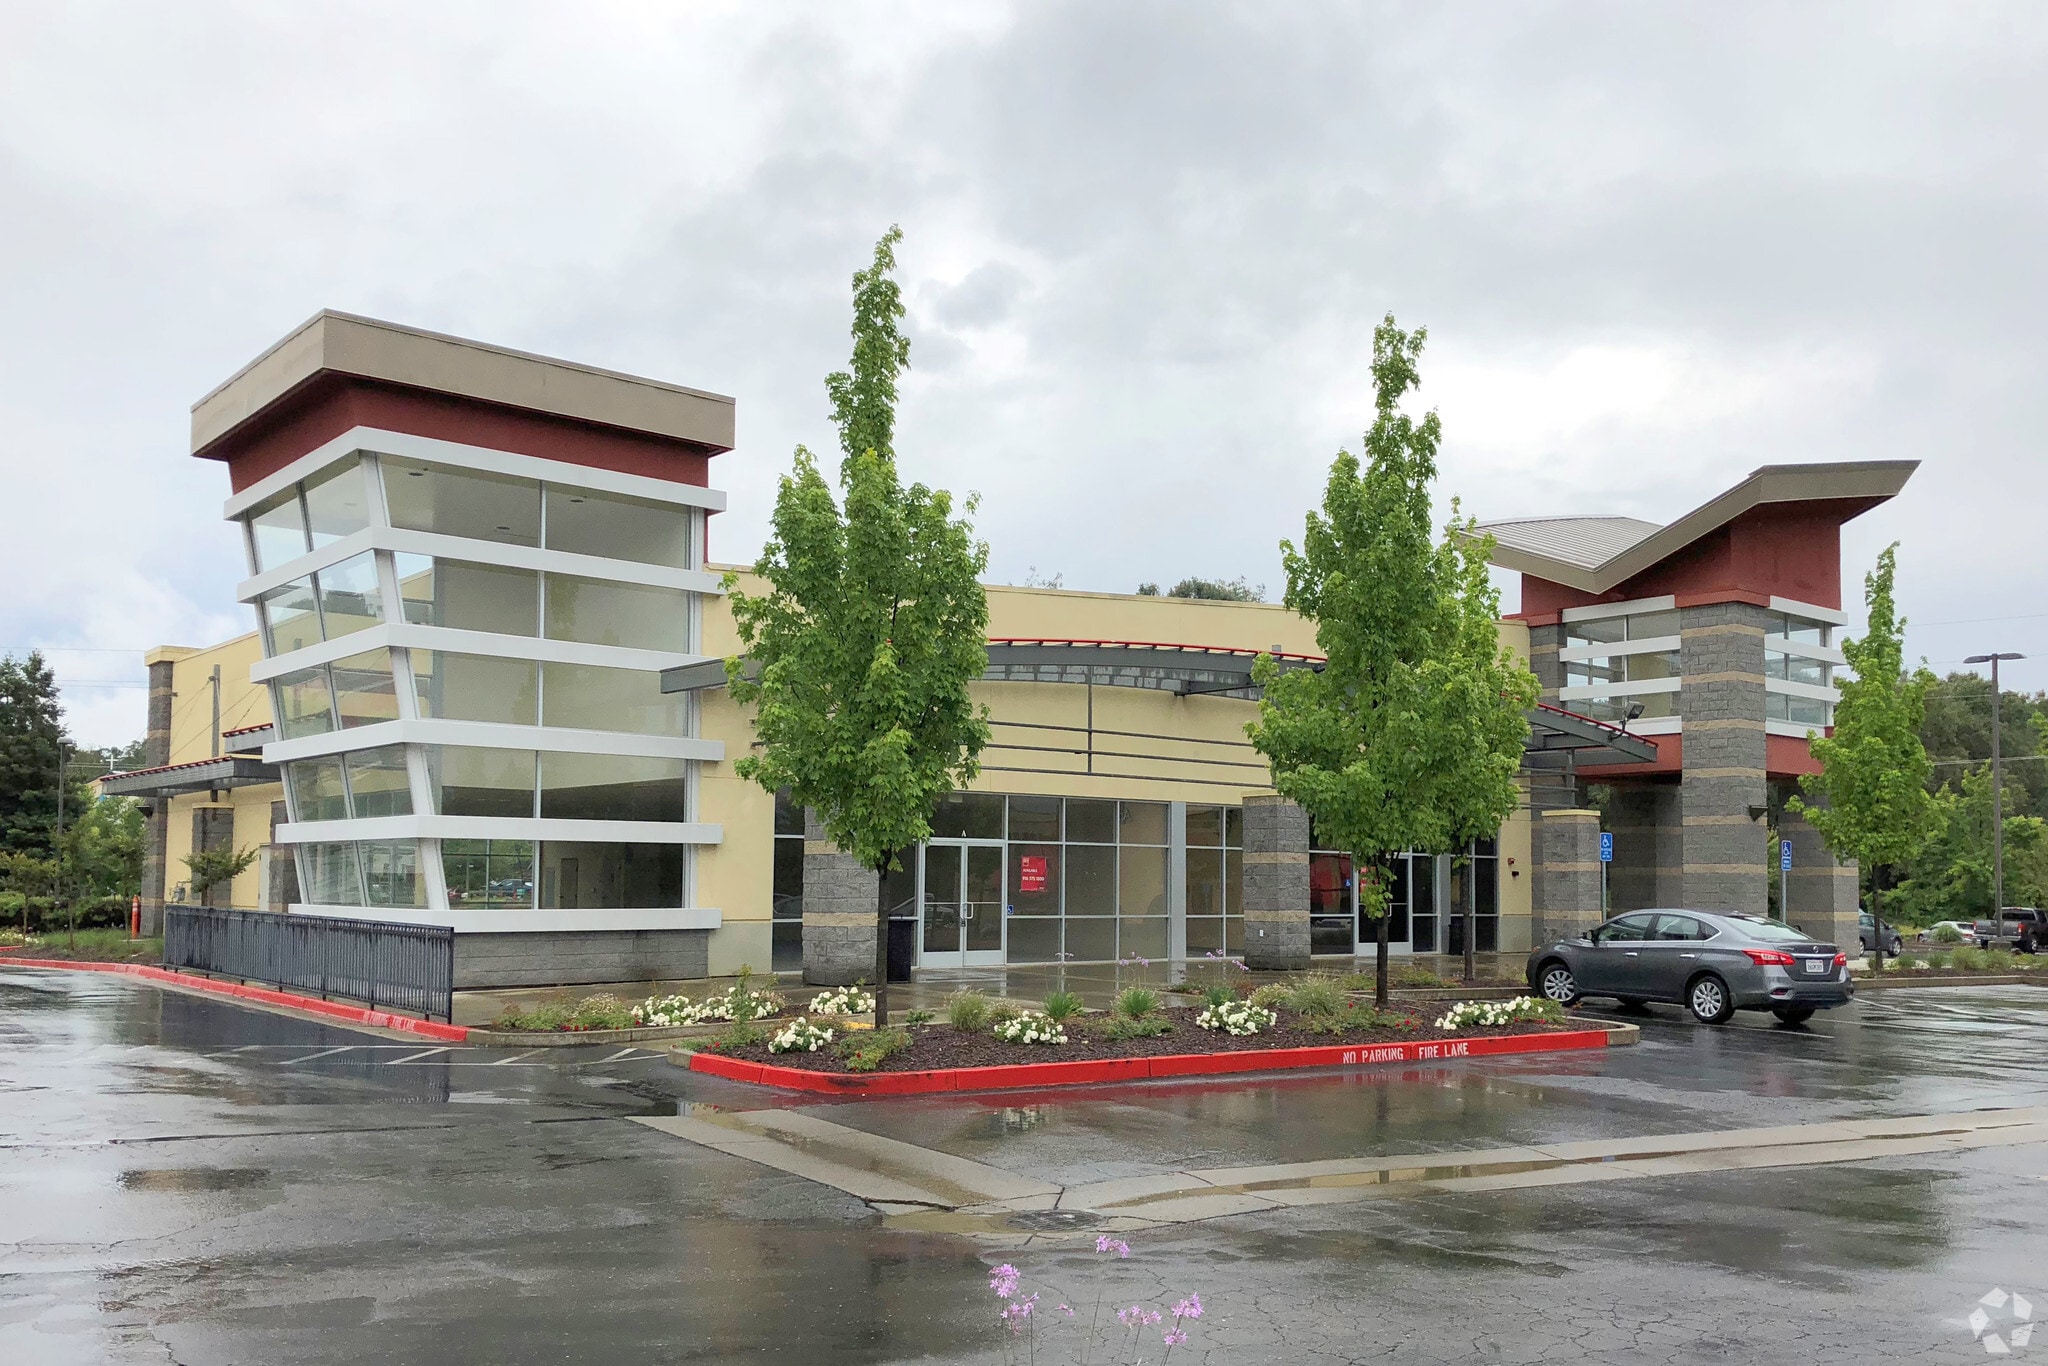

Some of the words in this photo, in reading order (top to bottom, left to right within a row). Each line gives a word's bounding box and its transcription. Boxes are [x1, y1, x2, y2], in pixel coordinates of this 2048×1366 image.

[1342, 1051, 1357, 1064] NO
[1361, 1047, 1404, 1063] PARKING
[1418, 1045, 1440, 1060] FIRE
[1444, 1042, 1469, 1058] LANE
